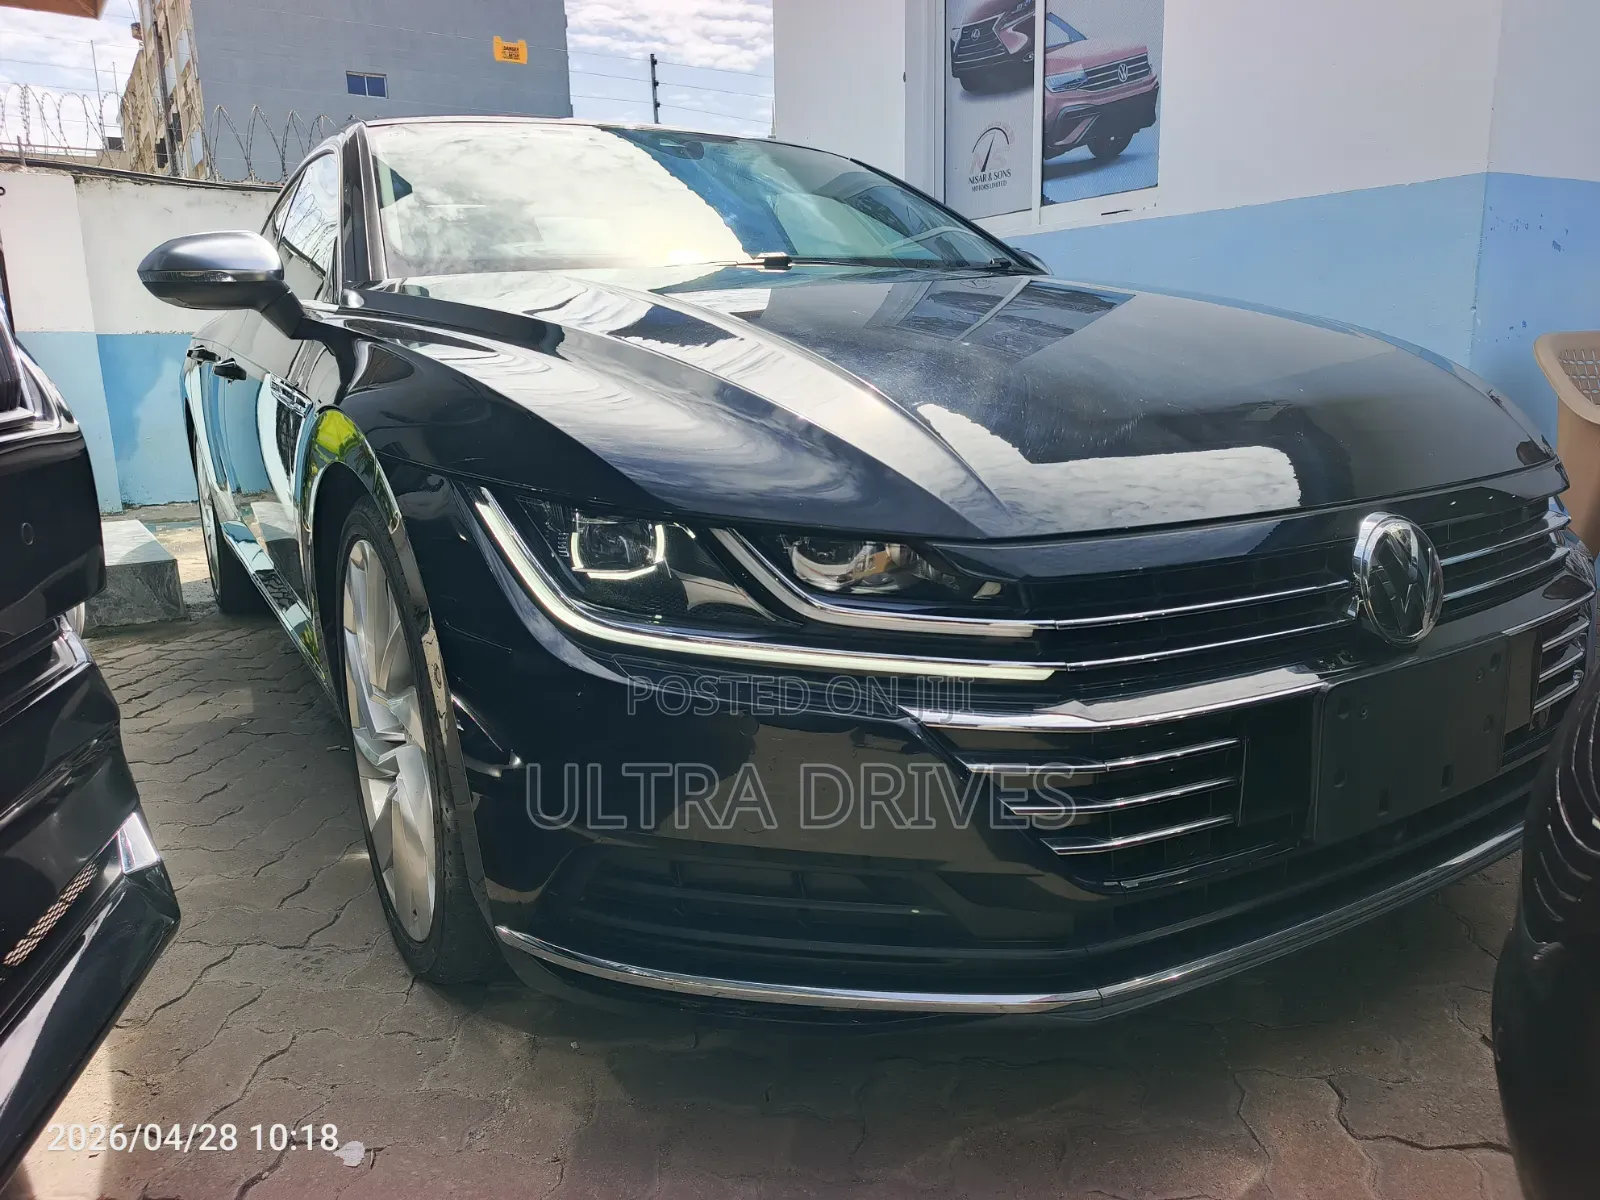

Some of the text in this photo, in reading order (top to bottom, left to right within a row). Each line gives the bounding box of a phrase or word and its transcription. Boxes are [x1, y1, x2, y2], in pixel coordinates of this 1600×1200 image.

[968, 169, 1011, 184] NISAR & SONS
